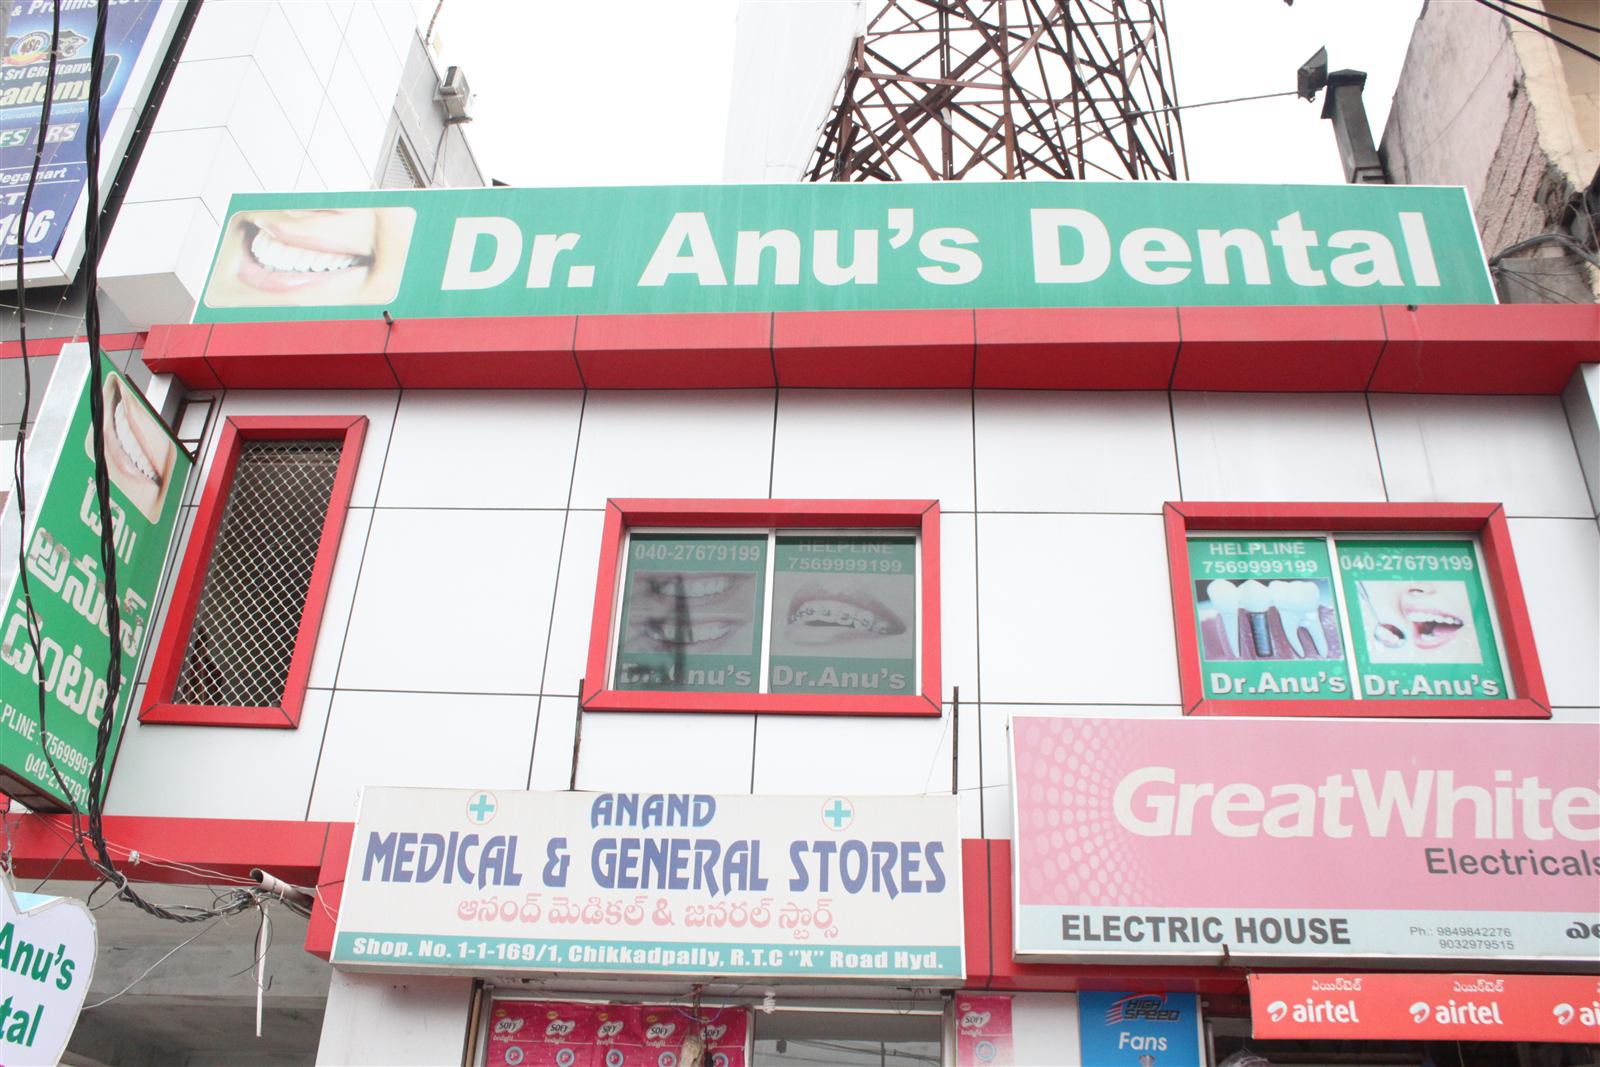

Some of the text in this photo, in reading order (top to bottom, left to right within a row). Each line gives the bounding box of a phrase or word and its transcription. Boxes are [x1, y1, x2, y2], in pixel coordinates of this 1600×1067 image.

[440, 207, 1441, 291] Dr. Anu's Dental
[634, 544, 761, 562] 040-27679199
[799, 540, 894, 555] HELPLINE
[1209, 542, 1306, 557] HELPLINE
[788, 557, 903, 573] 7569999199
[1202, 560, 1319, 575] 7569999199
[1340, 554, 1474, 572] 040-27679199
[772, 665, 907, 690] Dr.Anu's
[1210, 671, 1347, 695] Dr.Anu's
[1364, 673, 1500, 697] Dr.Anu's
[591, 793, 717, 829] ANAND
[361, 831, 946, 901] MEDICAL & GENERAL STORES
[457, 893, 542, 925] ఆనంద్
[547, 895, 648, 927] మెడికల్
[651, 898, 676, 927] &
[683, 897, 774, 929] జనరల్
[1061, 914, 1351, 946] ELECTRIC HOUSE
[1436, 926, 1512, 938] 9849842276
[0, 921, 76, 991] Anu's
[352, 937, 413, 958] Shop.
[418, 940, 451, 959] No.
[458, 942, 563, 964] 1-1-169/1,
[568, 943, 725, 968] Chikkadpally,
[730, 948, 784, 968] R.T.C
[830, 950, 888, 969] Road
[894, 951, 944, 971] Hyd.
[1439, 938, 1515, 950] 9032979515
[1292, 998, 1360, 1023] airtel
[1434, 999, 1504, 1025] airtel
[1119, 1031, 1168, 1051] Fans
